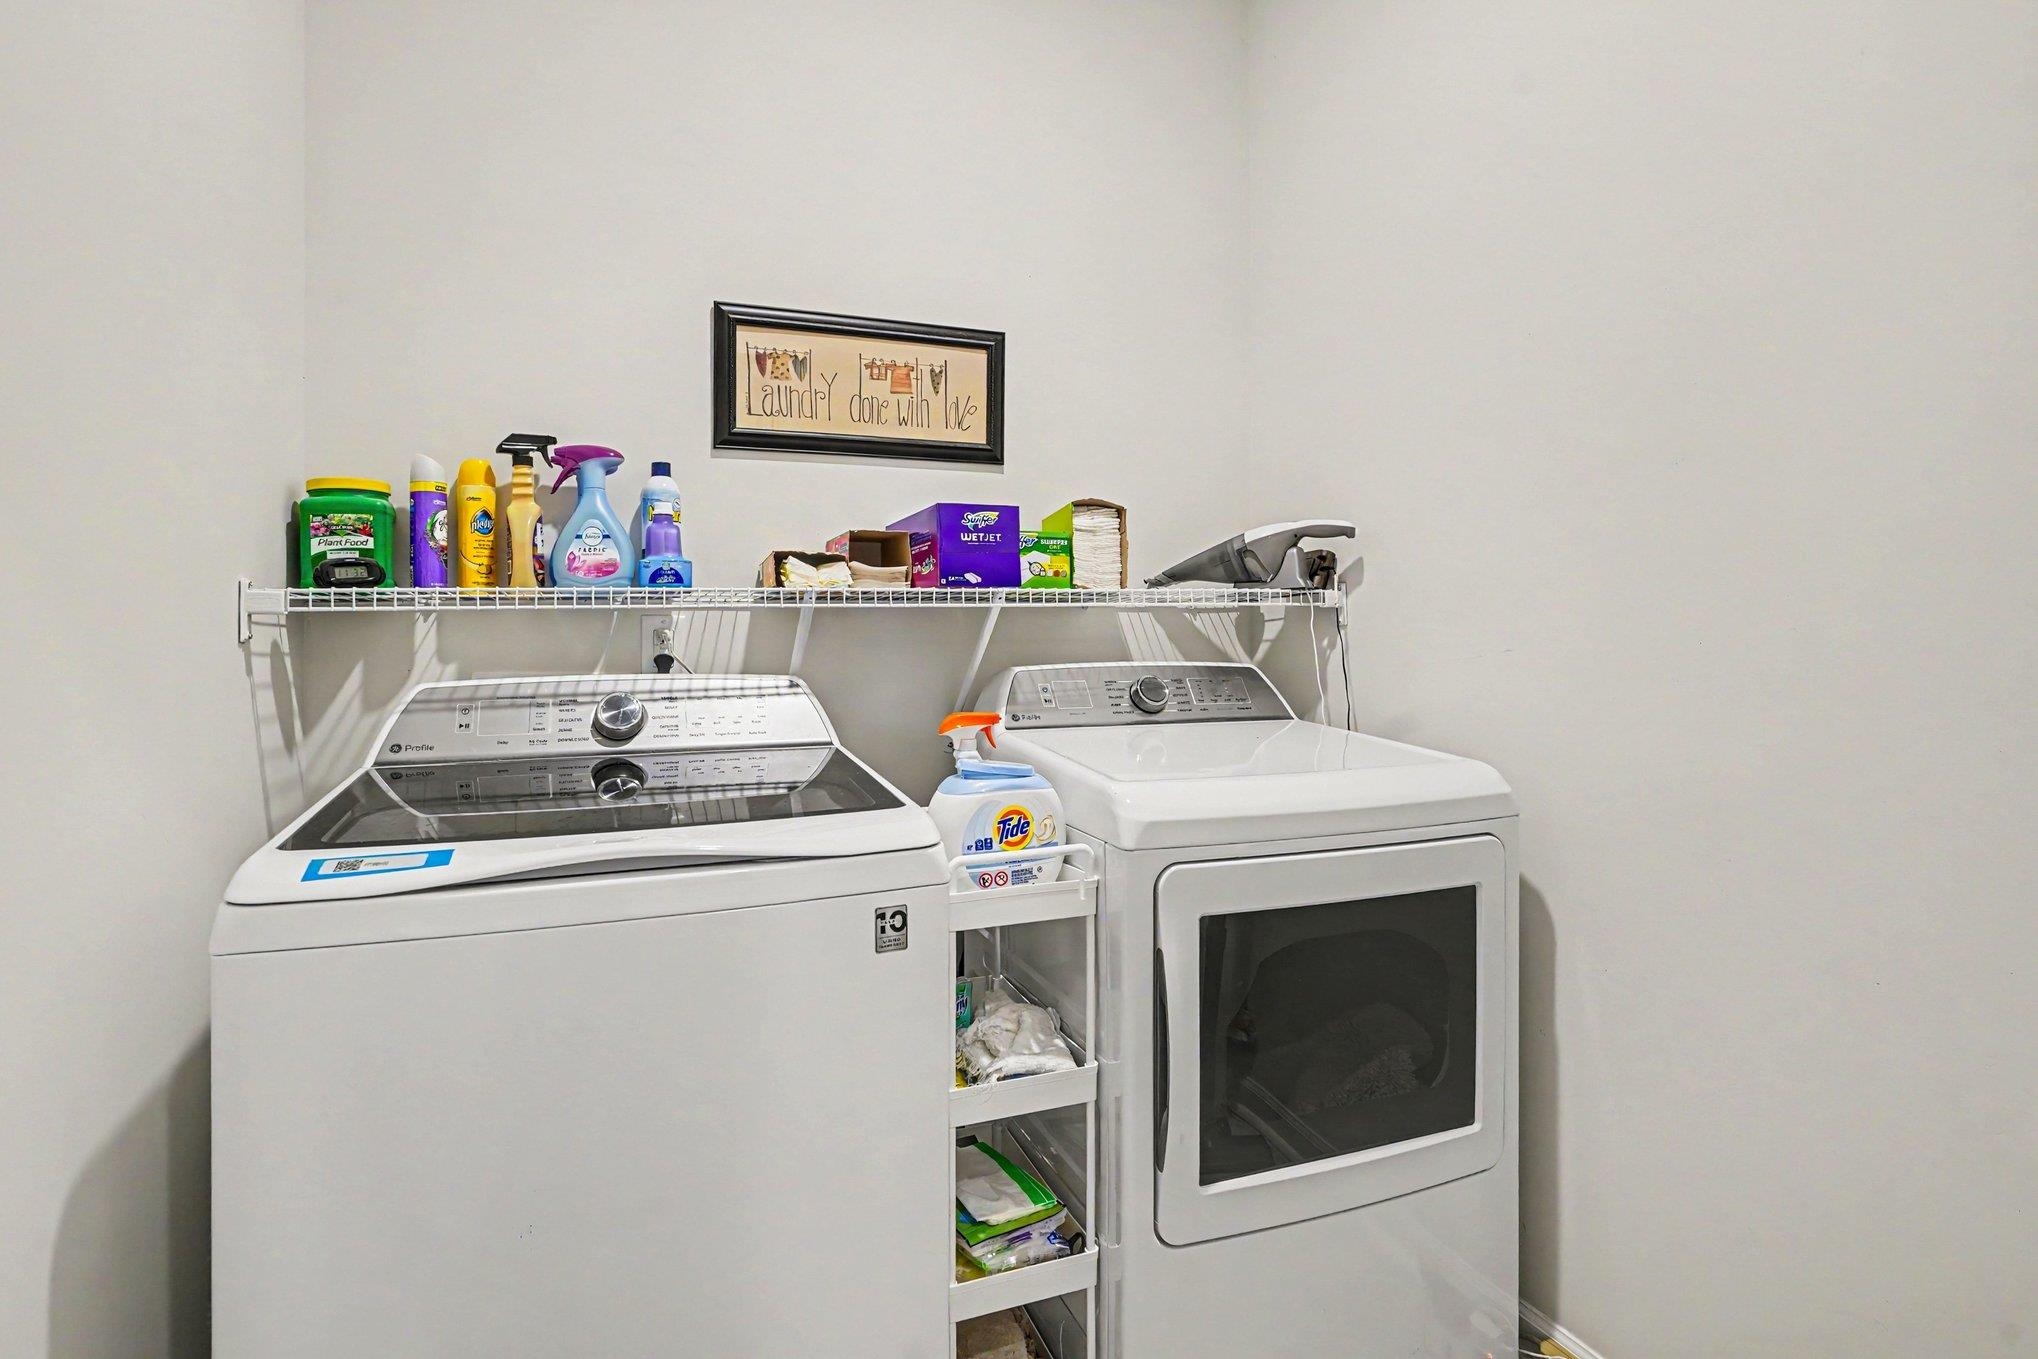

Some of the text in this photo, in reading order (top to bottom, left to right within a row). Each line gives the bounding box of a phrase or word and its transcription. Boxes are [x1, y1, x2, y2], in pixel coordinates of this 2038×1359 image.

[849, 353, 888, 424] done
[897, 357, 930, 428] with
[944, 360, 978, 431] love
[961, 511, 998, 529] Swiffer
[318, 538, 369, 547] Plant Food
[960, 532, 1002, 542] WETJET
[404, 744, 435, 752] Profile
[996, 813, 1030, 845] Tide
[876, 909, 907, 935] 10
